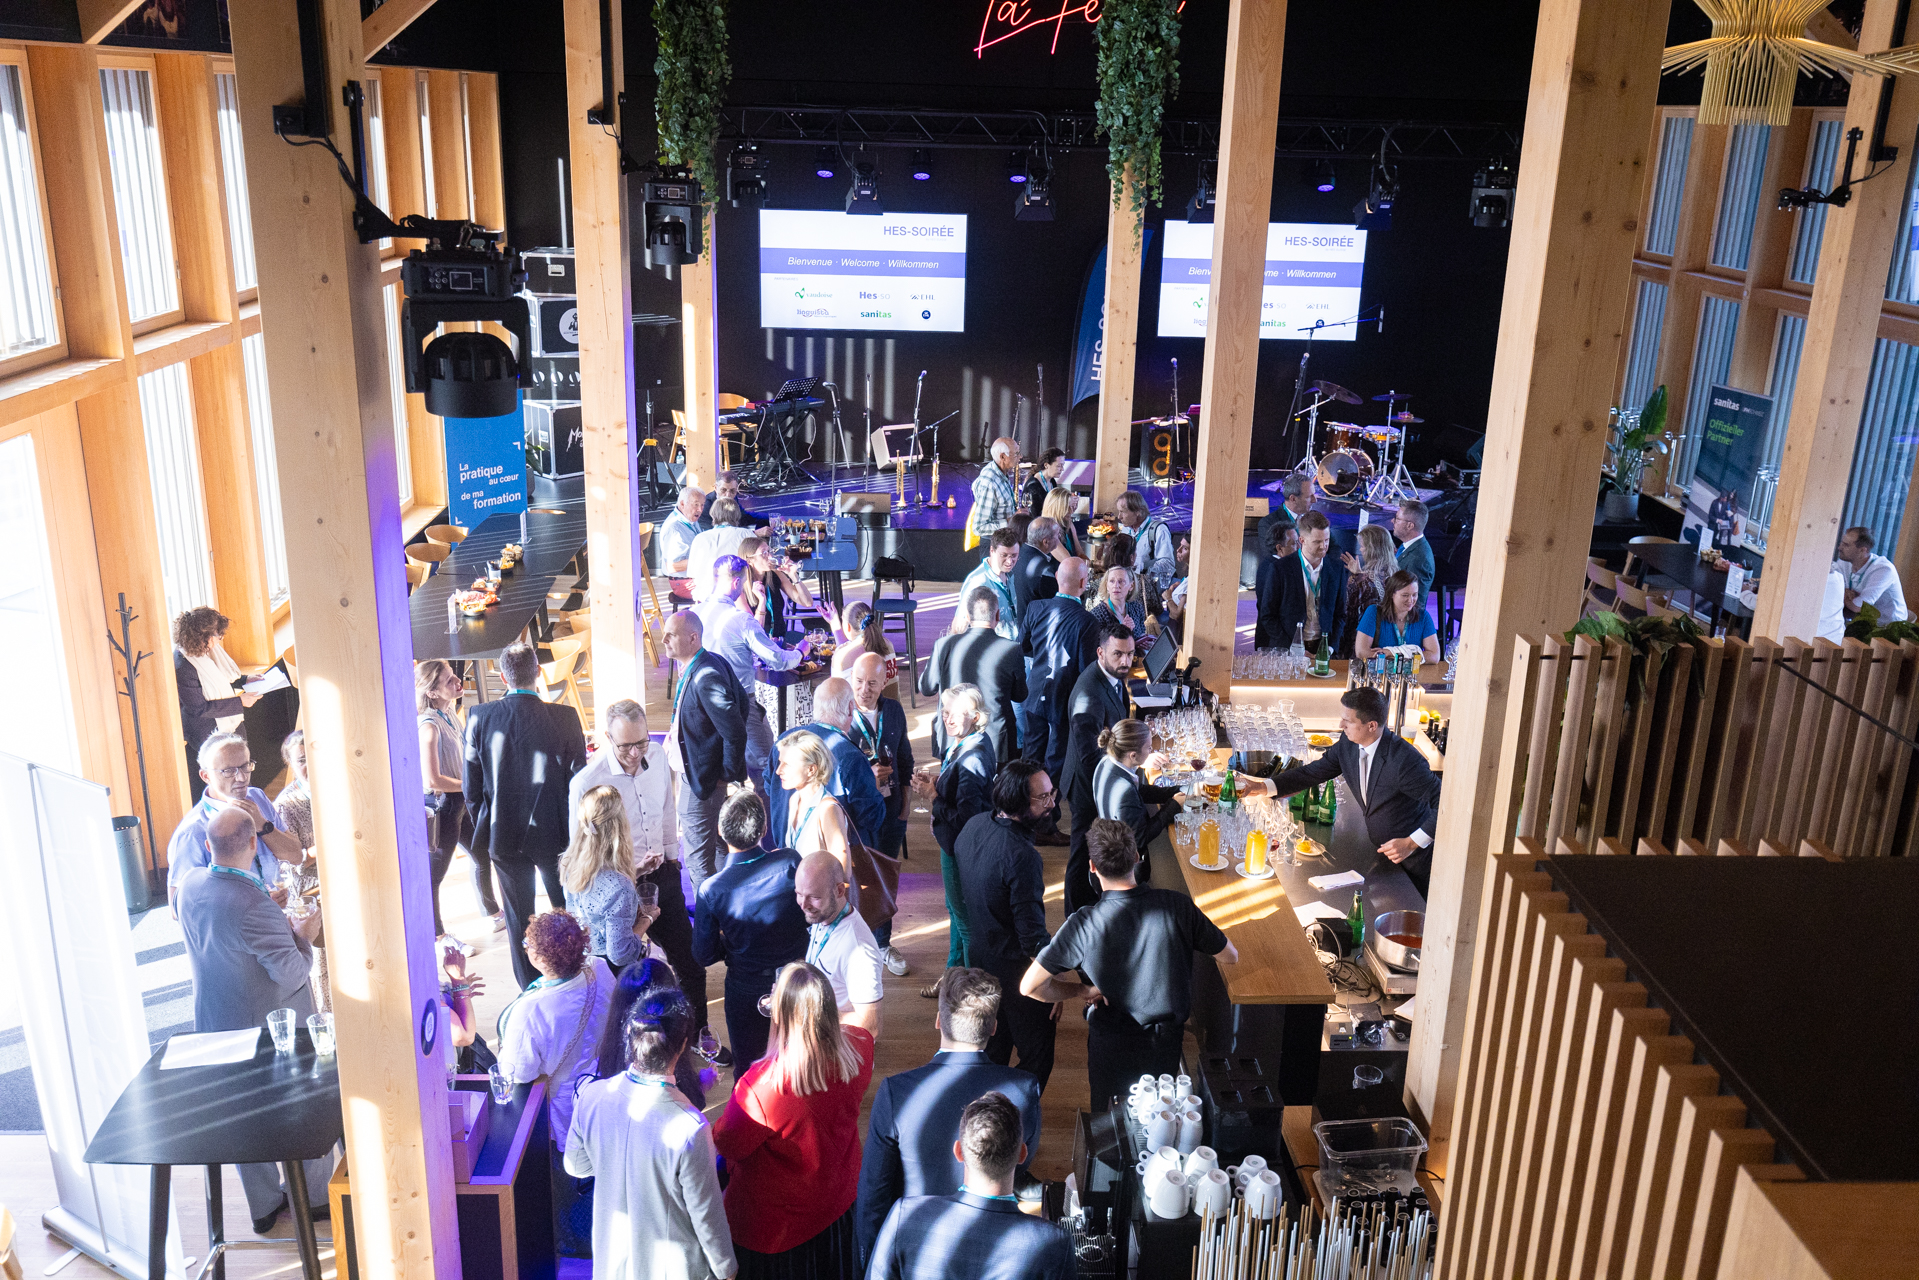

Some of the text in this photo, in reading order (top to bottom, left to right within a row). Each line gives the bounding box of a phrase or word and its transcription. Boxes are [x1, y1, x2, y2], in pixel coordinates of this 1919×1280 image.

[883, 224, 955, 237] HES-SOIRÉE
[1284, 235, 1355, 248] HES-SOIRÉE
[787, 256, 939, 269] Bienvenue Welcome Willkommen
[1188, 266, 1212, 276] Bienv
[1286, 269, 1337, 279] Willkommen
[860, 310, 892, 318] sanitas
[1260, 319, 1287, 328] anitas
[1713, 397, 1740, 411] sanitas
[1709, 418, 1744, 437] Offizieller
[1706, 430, 1734, 446] Partner
[459, 463, 469, 472] La
[460, 465, 504, 484] pratique
[488, 473, 519, 486] au cœur
[461, 490, 484, 501] de ma
[473, 492, 522, 510] formation
